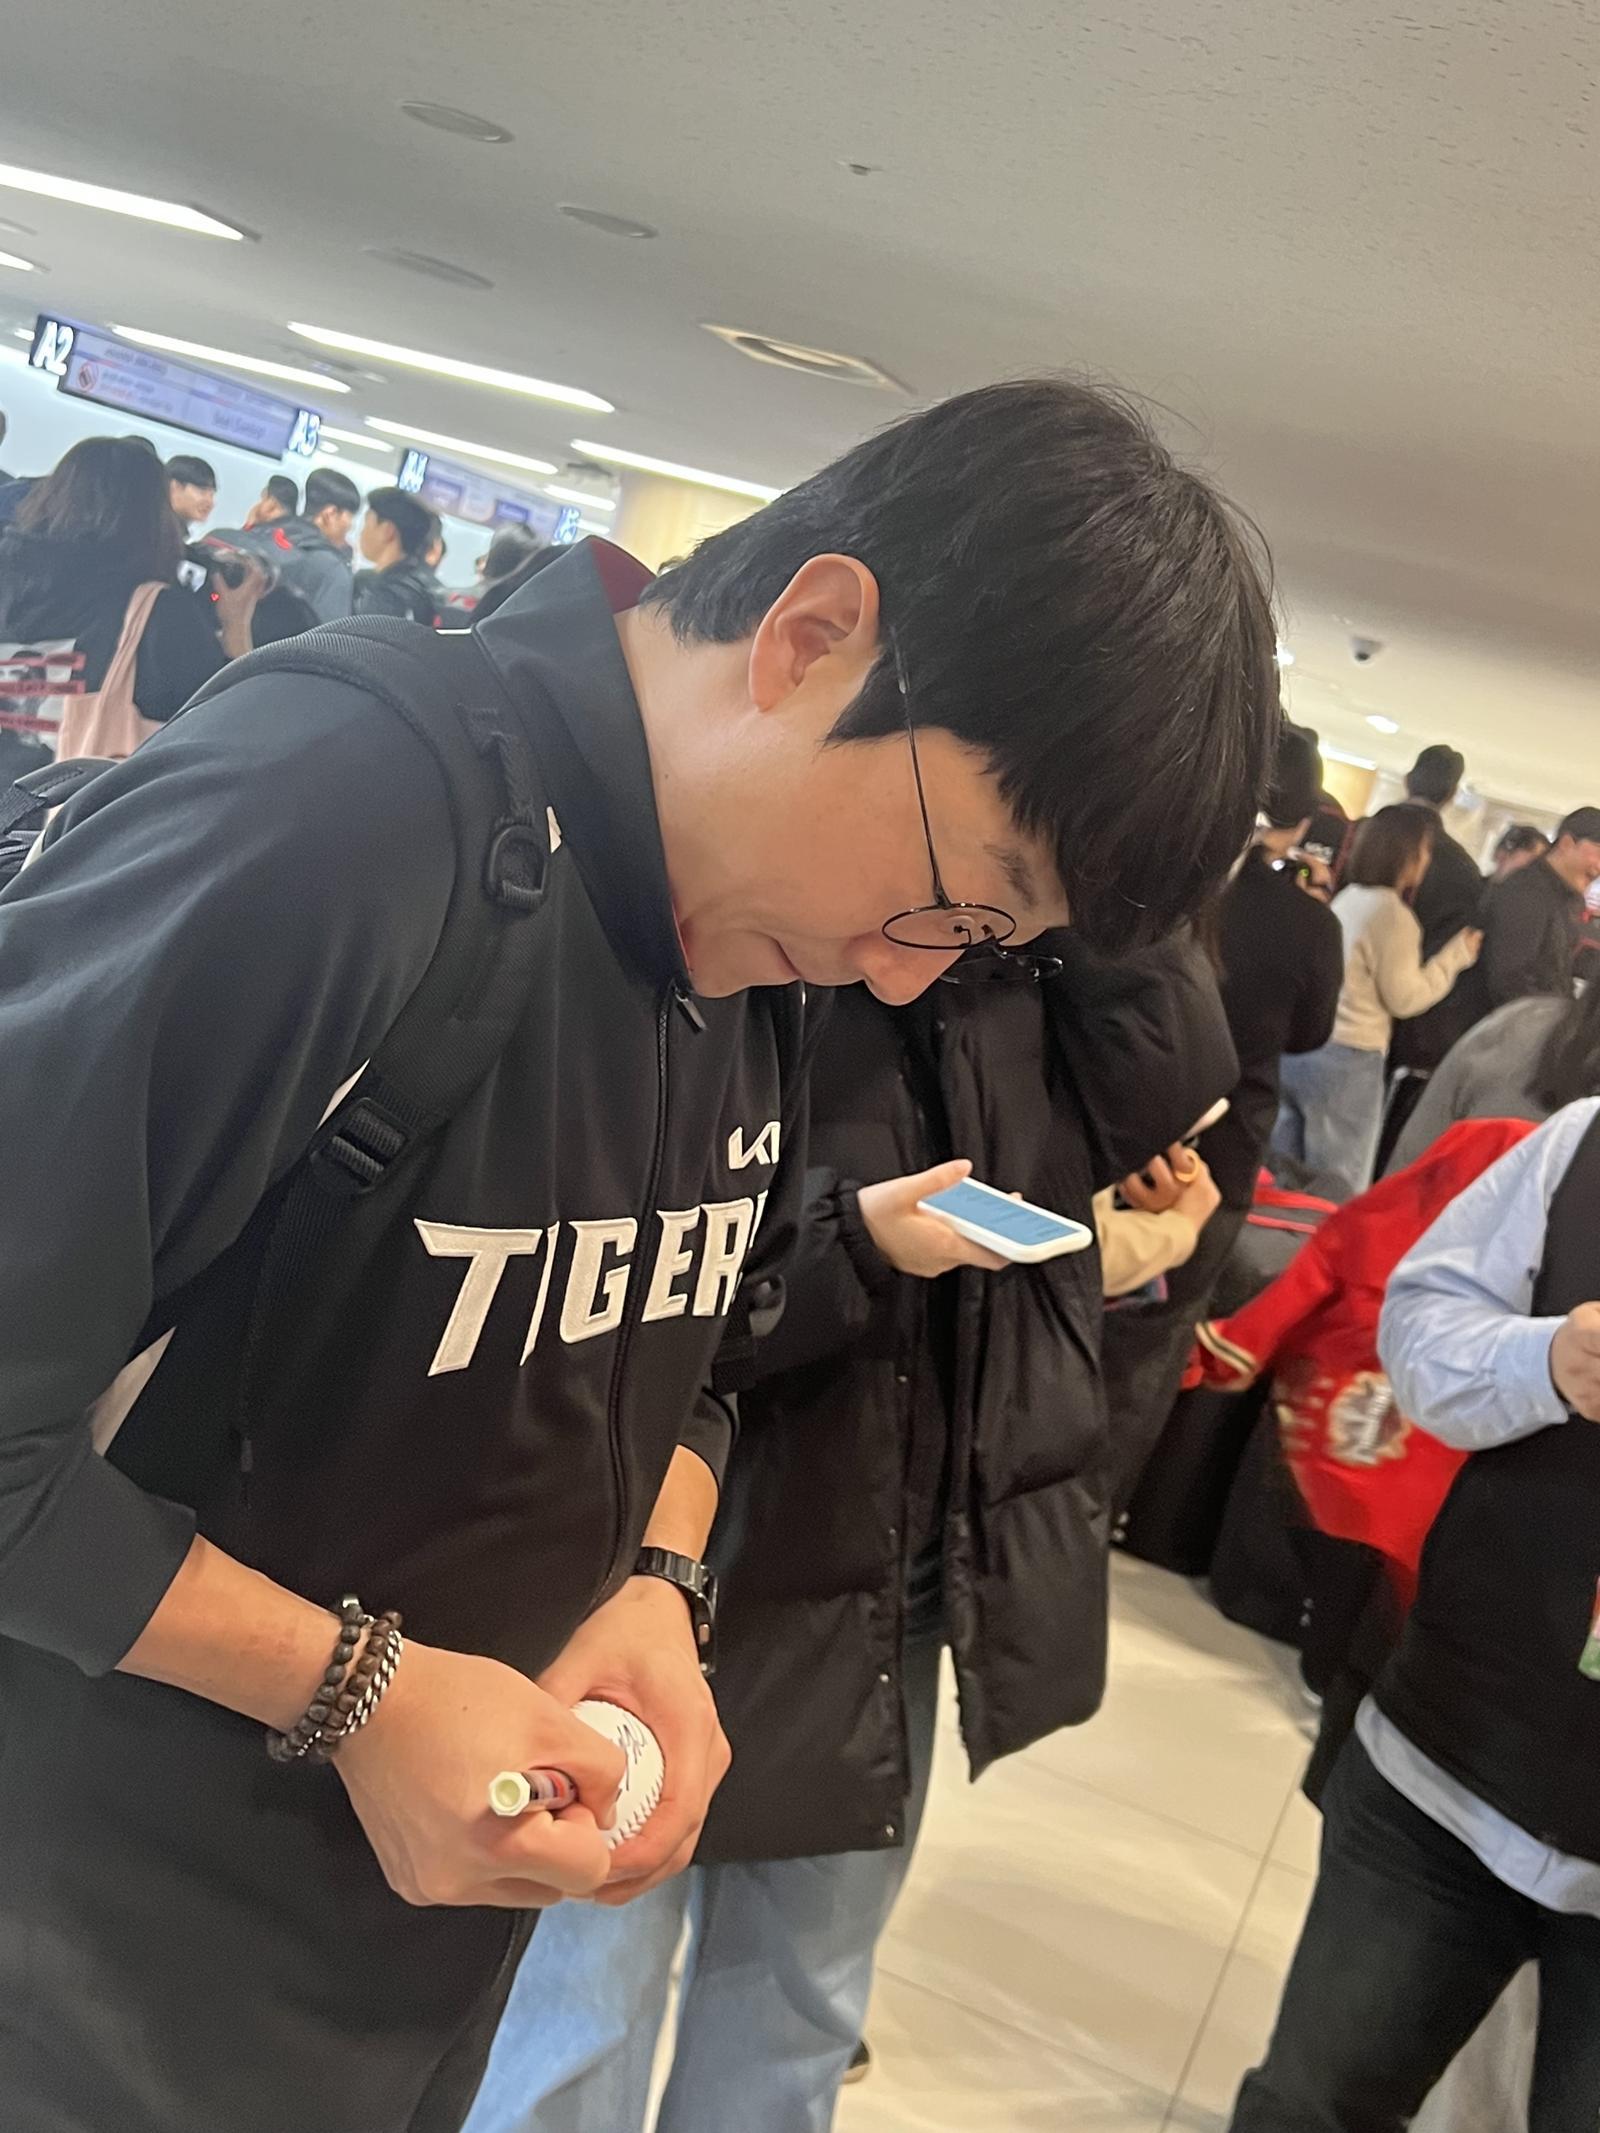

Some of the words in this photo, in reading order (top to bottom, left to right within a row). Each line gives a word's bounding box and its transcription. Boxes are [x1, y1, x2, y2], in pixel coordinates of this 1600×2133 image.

[32, 320, 74, 376] A2
[288, 410, 320, 456] A3
[413, 1190, 768, 1377] TIGER
